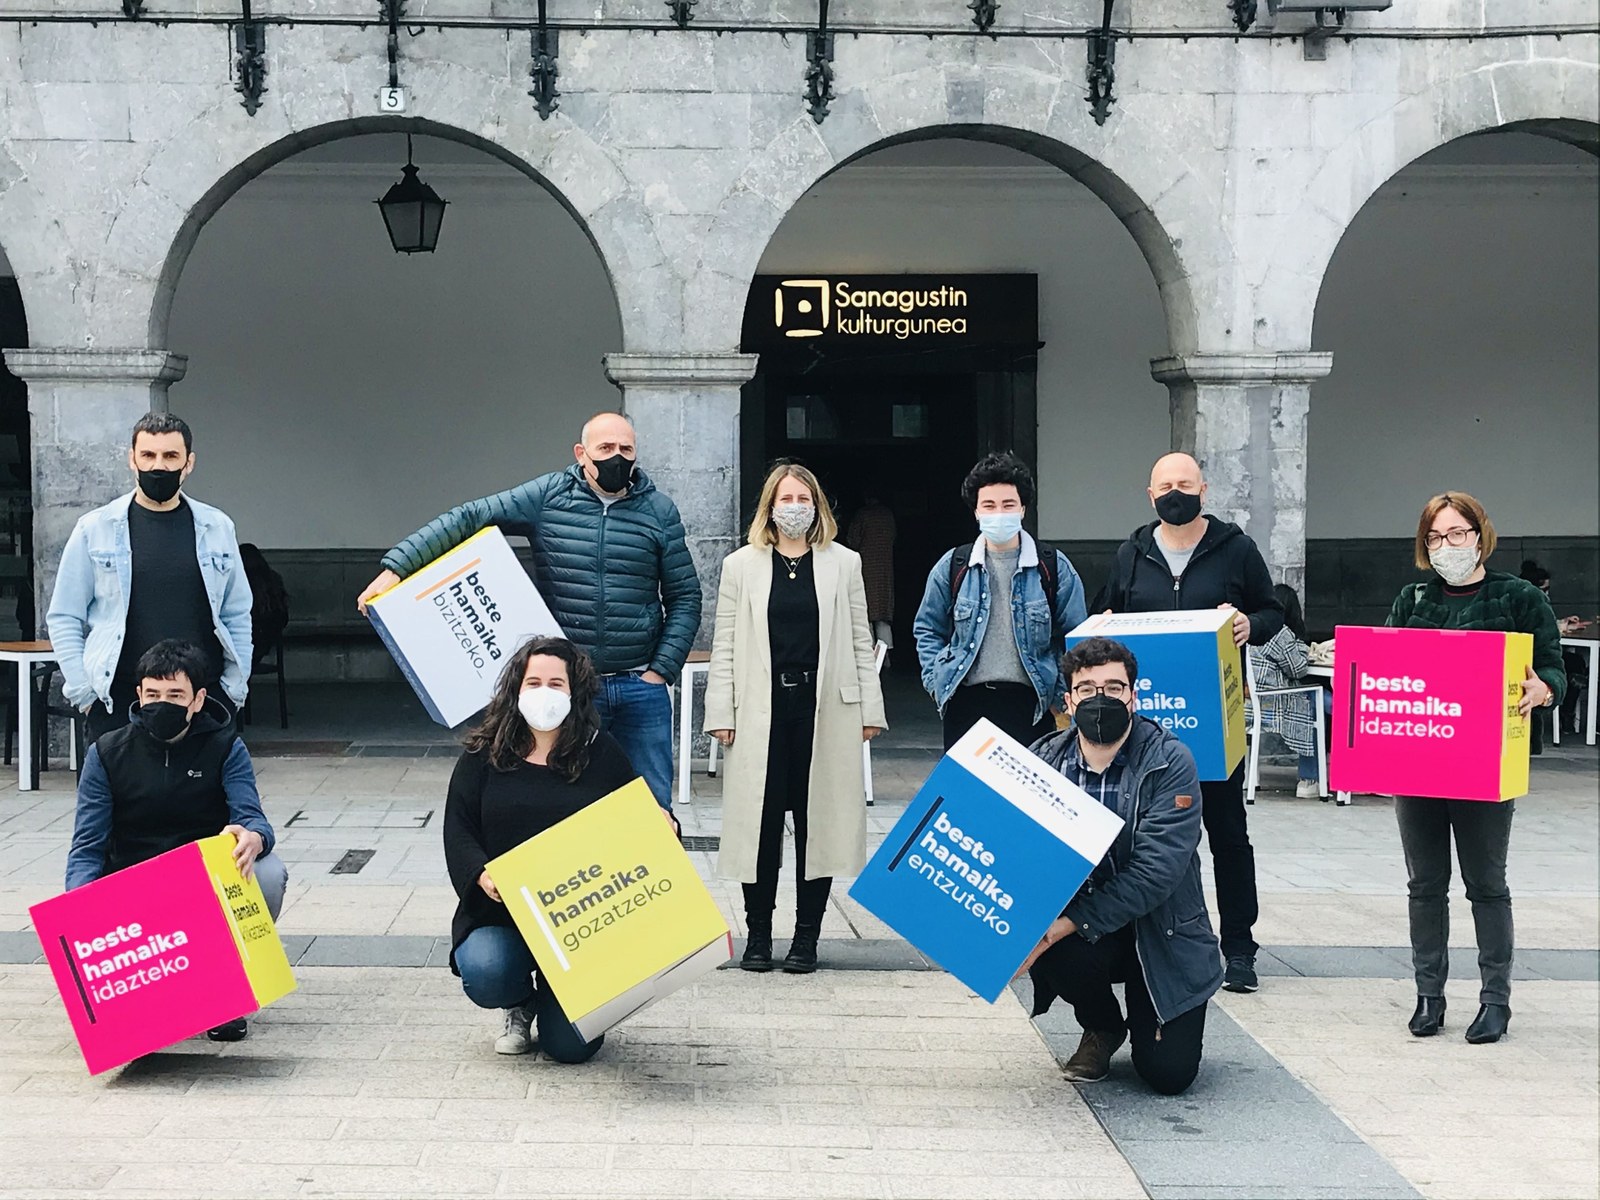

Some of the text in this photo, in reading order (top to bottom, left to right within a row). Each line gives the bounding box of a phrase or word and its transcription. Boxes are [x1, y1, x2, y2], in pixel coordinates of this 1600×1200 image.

[387, 90, 398, 107] 5
[835, 281, 967, 312] Sanagustin
[837, 309, 967, 339] kulturgunea
[449, 581, 502, 661] hamaika
[466, 571, 502, 623] beste
[1360, 694, 1462, 717] hamaika
[1361, 672, 1426, 693] beste
[1360, 716, 1455, 739] idazteko
[933, 812, 995, 867] beste
[537, 864, 603, 907] beste
[908, 854, 1010, 935] entzuteko
[920, 830, 1014, 911] hamaika
[548, 864, 650, 928] hamaika
[563, 879, 672, 952] gozatzeko
[74, 922, 142, 959] beste
[82, 930, 188, 982] hamaika
[91, 955, 190, 1003] idazteko
